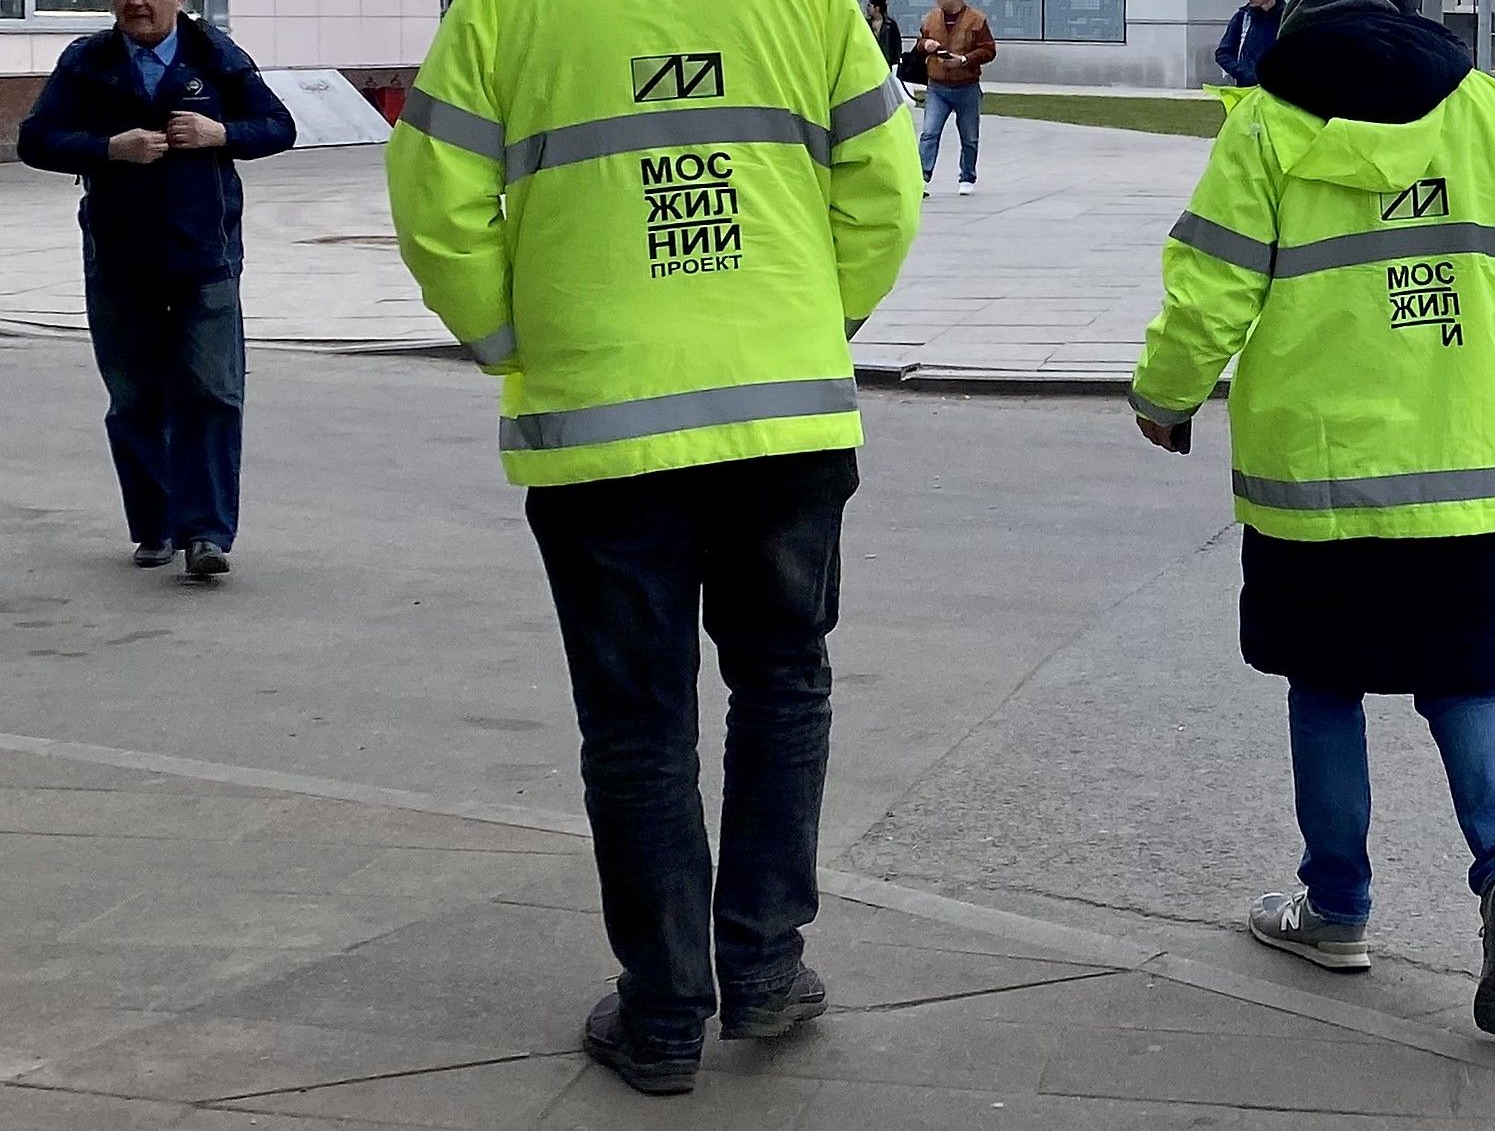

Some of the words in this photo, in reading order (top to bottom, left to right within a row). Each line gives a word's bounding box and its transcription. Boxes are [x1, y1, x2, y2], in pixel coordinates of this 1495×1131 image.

[640, 152, 733, 186] МОС
[644, 188, 739, 223] ЖИЛ
[648, 224, 742, 260] НИИ
[651, 254, 743, 279] ПРОЕКТ
[1387, 262, 1456, 290] МОС
[1389, 292, 1461, 322] ЖИЛ
[1440, 323, 1464, 347] И
[1281, 905, 1301, 931] N
